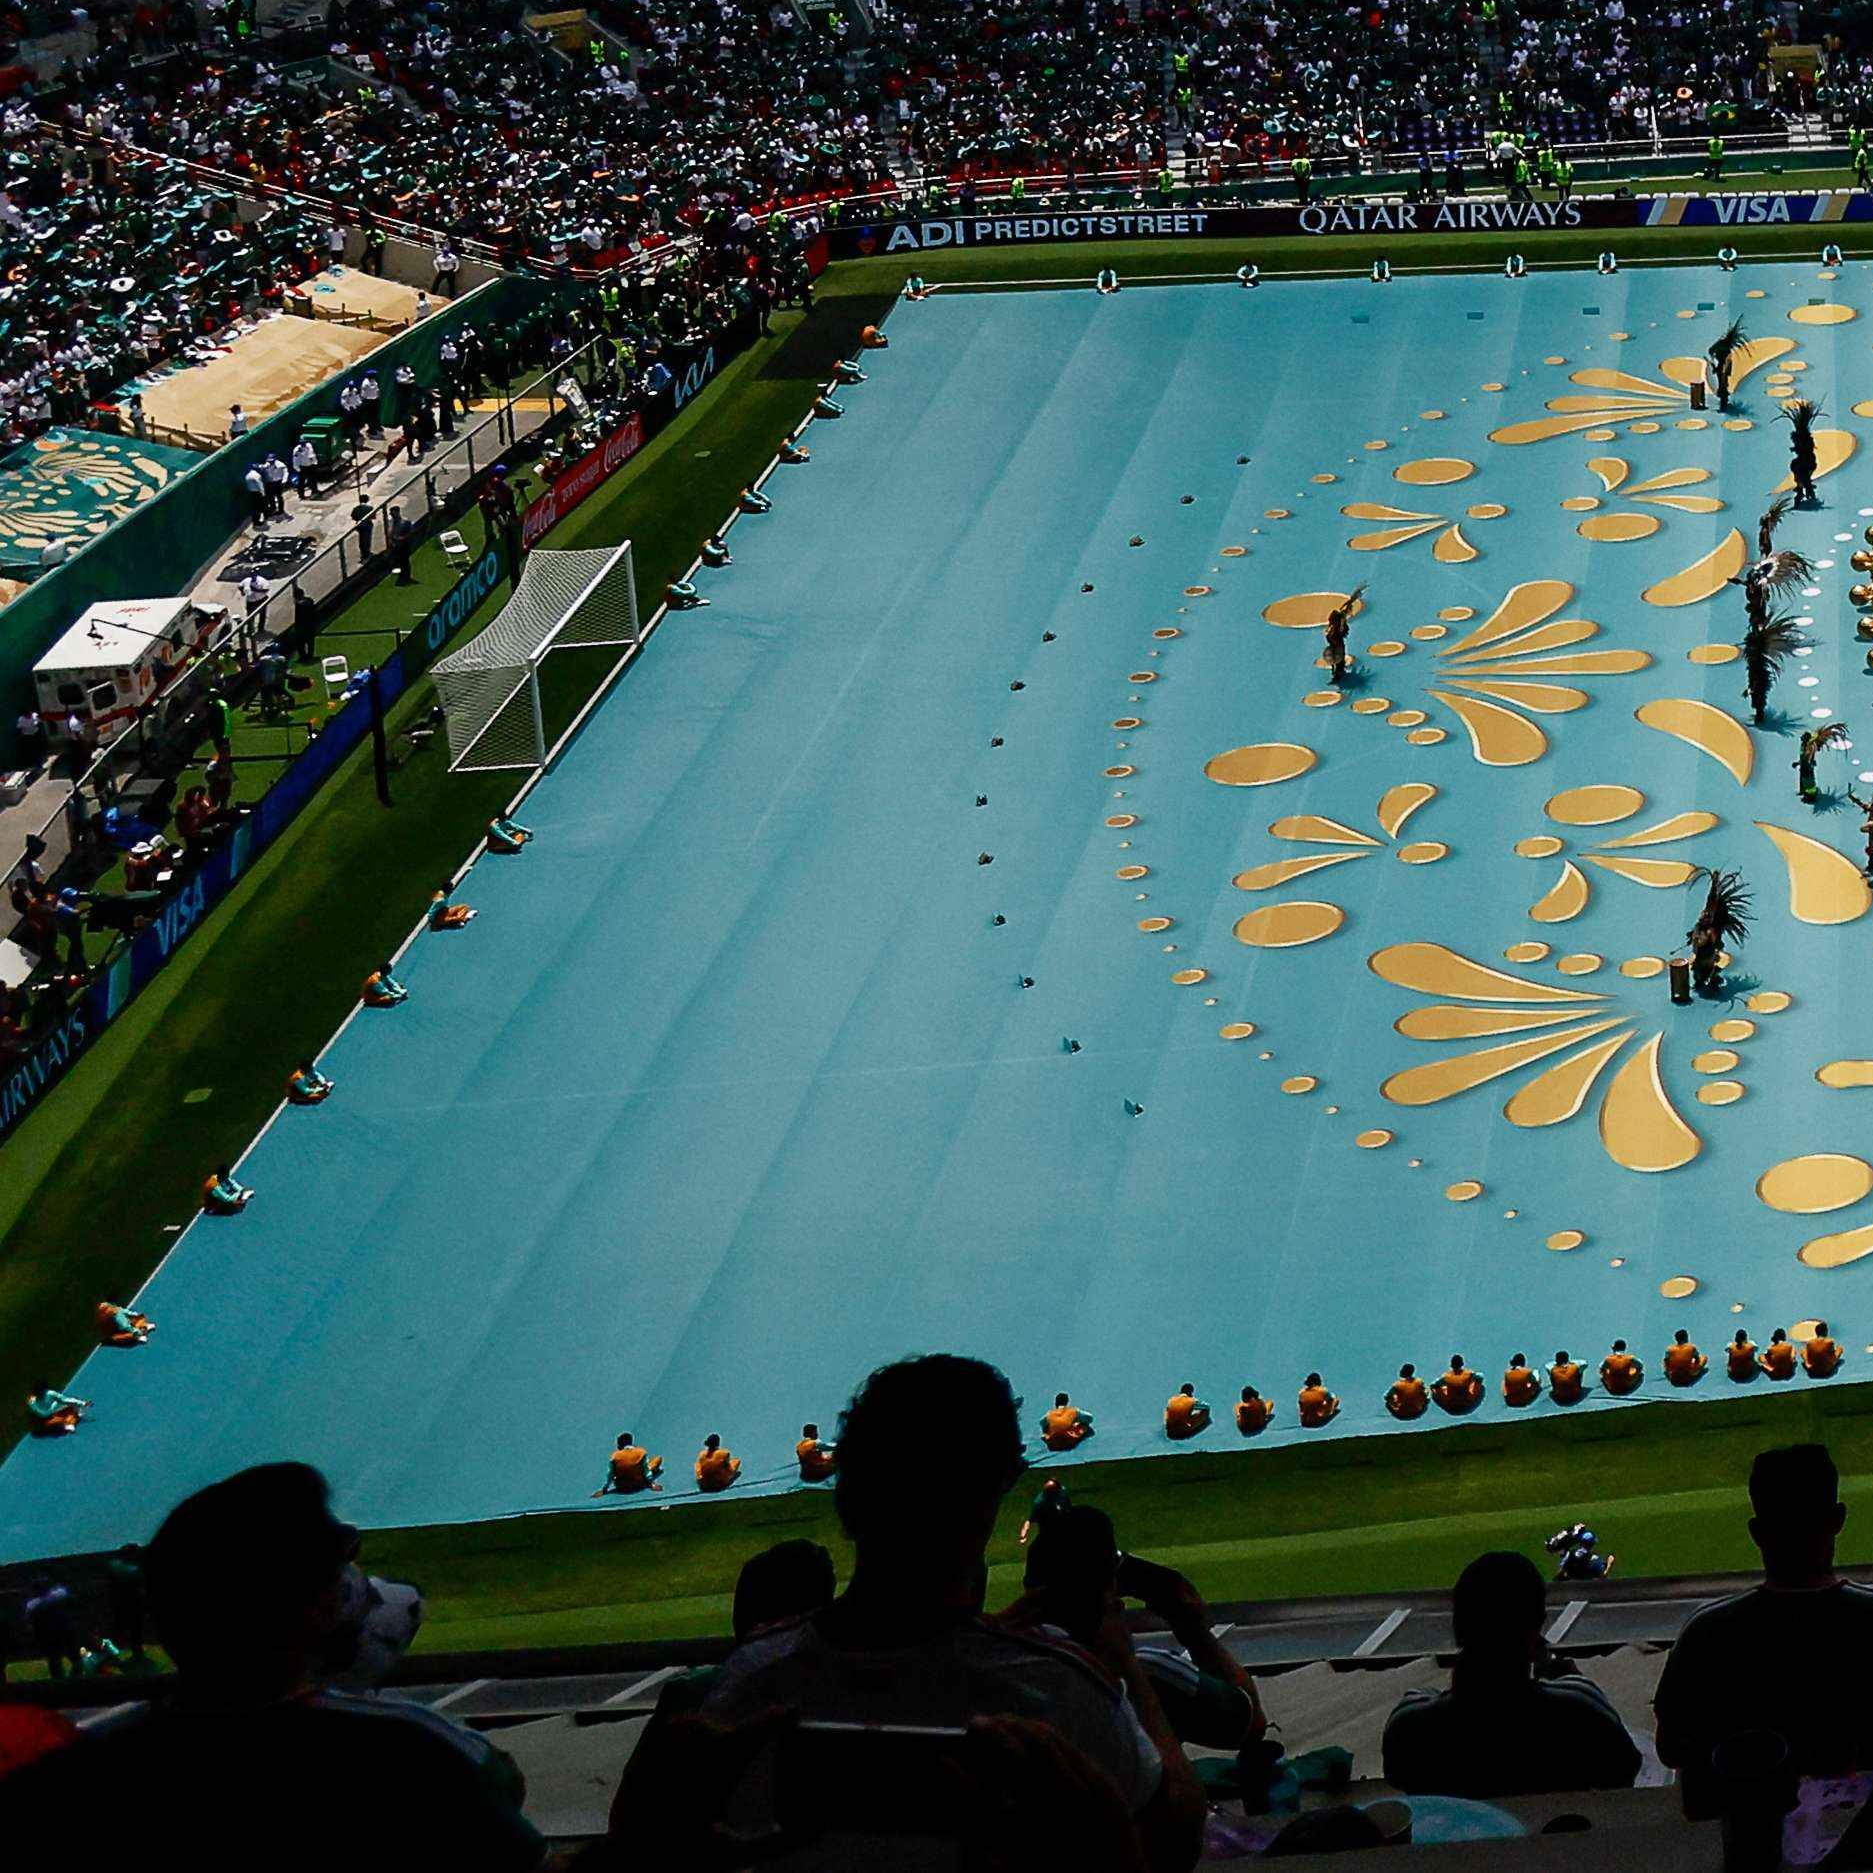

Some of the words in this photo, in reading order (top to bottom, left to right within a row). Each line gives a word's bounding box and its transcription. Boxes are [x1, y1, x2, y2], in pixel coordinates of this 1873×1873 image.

[1299, 204, 1418, 234] QATAR
[1433, 202, 1584, 230] AIRWAYS
[1712, 197, 1791, 224] VISA
[886, 220, 966, 252] ADI
[974, 214, 1208, 241] PREDICTSTREET
[427, 551, 498, 652] aramco
[152, 874, 206, 957] VISA
